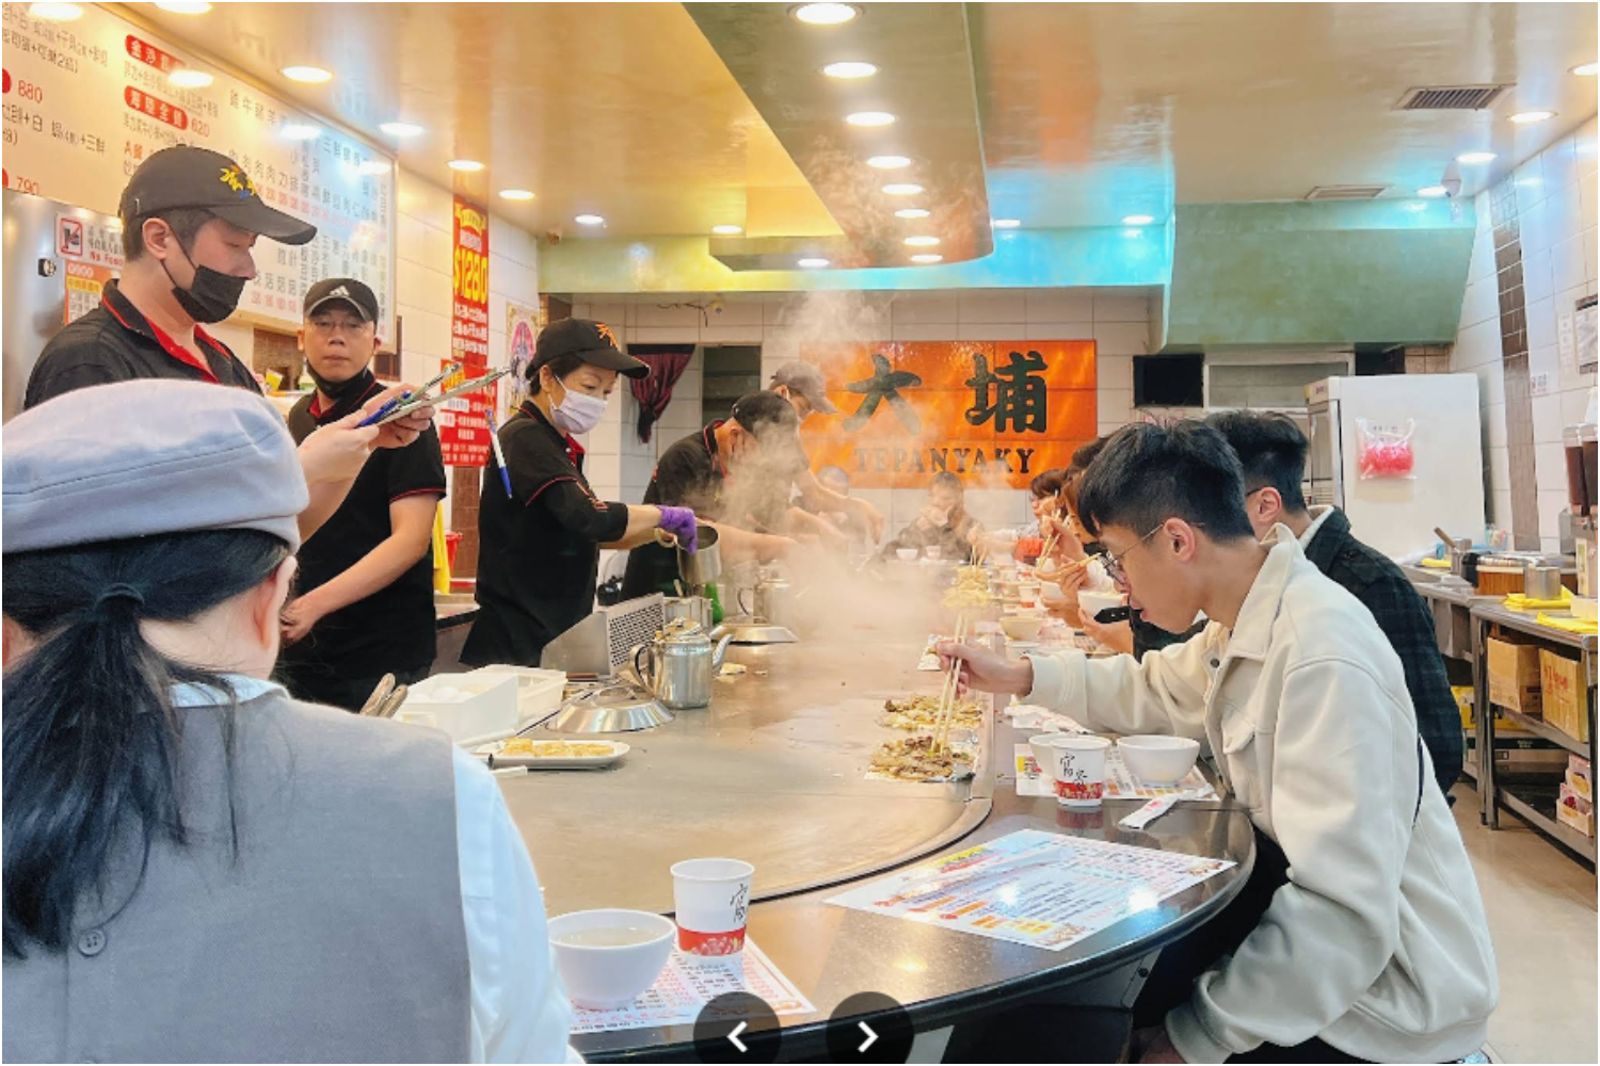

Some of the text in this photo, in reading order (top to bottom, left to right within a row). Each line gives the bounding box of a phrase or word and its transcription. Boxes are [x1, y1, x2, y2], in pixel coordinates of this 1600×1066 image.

[18, 80, 43, 104] 880
[453, 246, 489, 304] $1280
[842, 351, 1048, 434] 大埔
[854, 448, 1035, 474] TEPANYAKY
